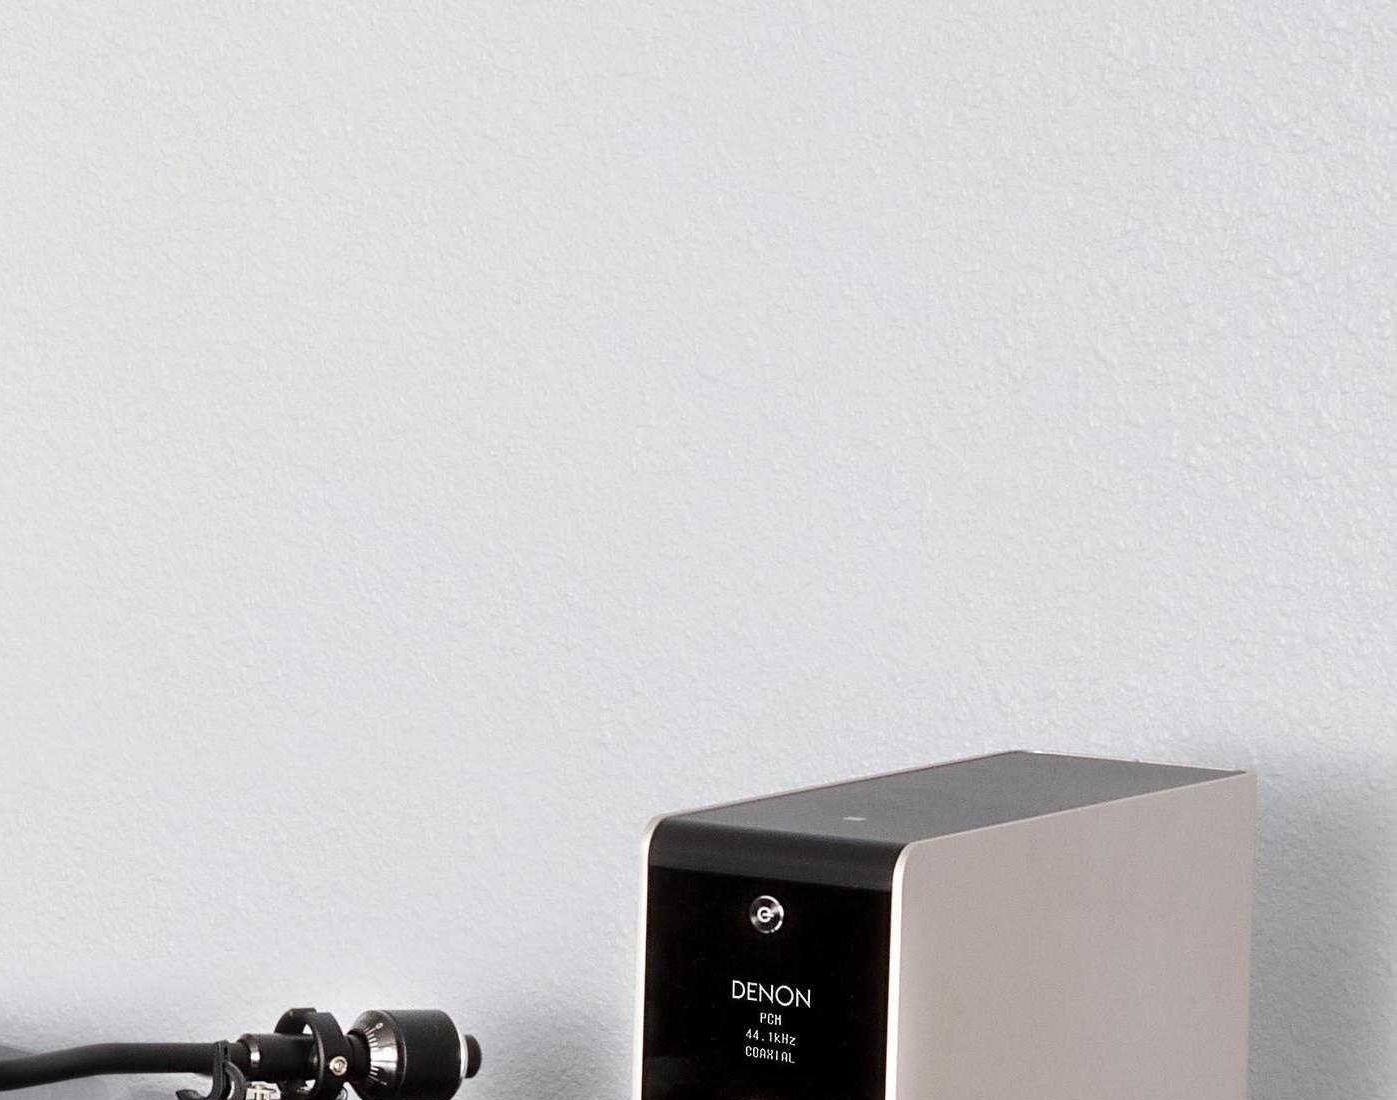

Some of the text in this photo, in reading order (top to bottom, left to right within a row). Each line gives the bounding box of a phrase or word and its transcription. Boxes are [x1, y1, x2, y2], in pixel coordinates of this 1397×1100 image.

[732, 979, 811, 1008] DENON
[760, 1012, 782, 1026] PCM
[745, 1028, 796, 1046] 44.1kHz
[745, 1045, 795, 1064] COAXIAL
